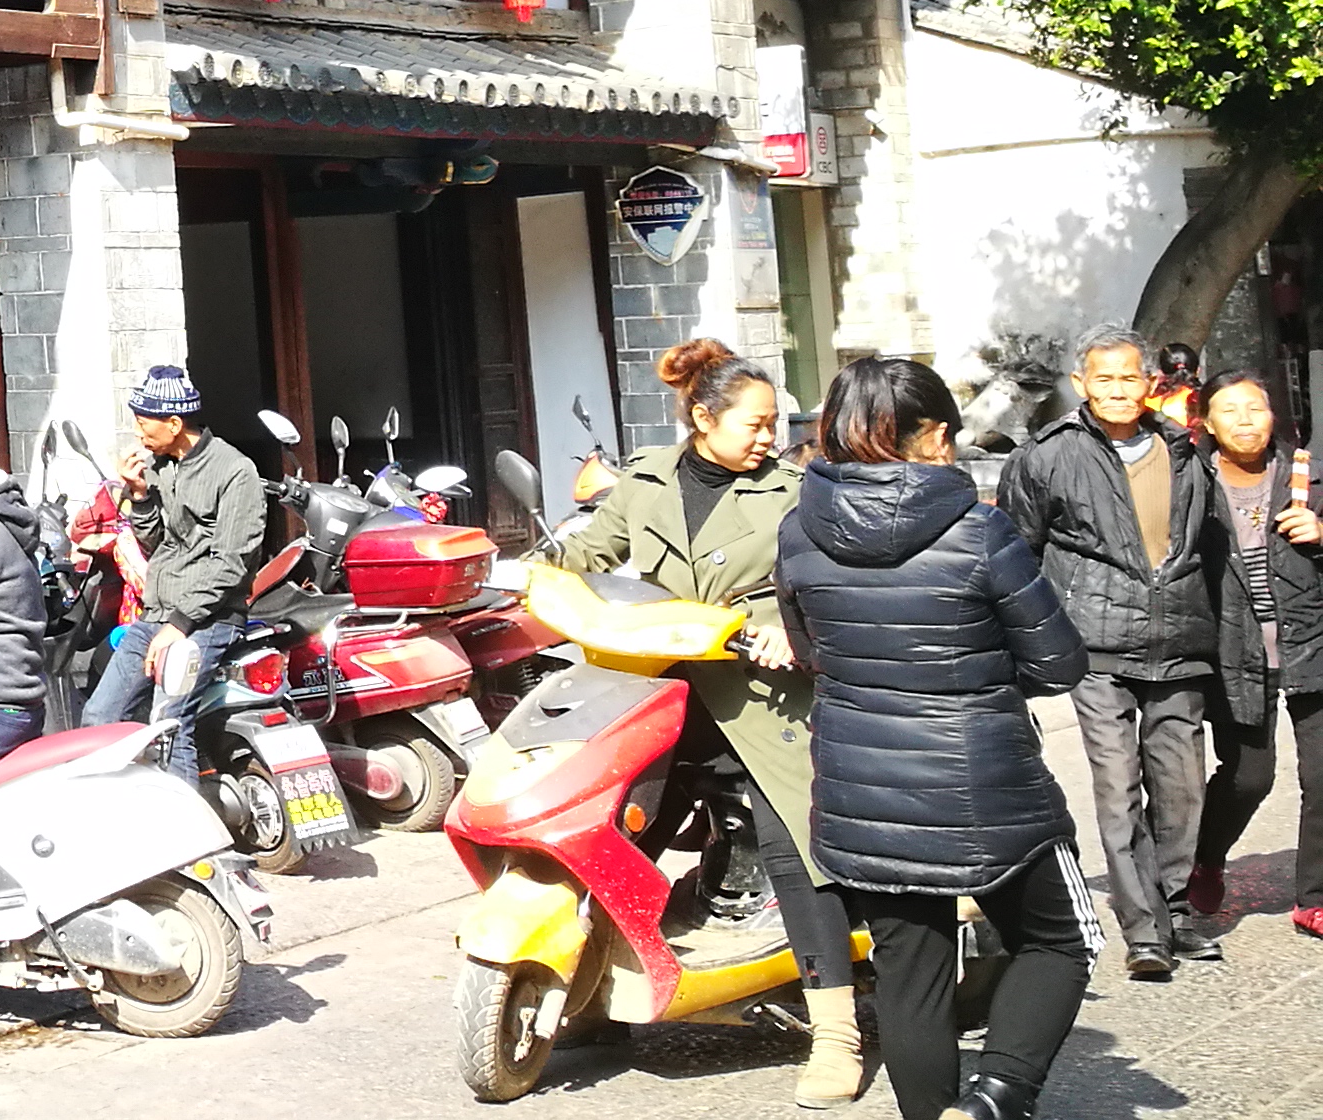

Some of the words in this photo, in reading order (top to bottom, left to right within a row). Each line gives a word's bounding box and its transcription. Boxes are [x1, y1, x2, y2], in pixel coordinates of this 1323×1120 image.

[622, 201, 700, 218] 安保联网报警中
